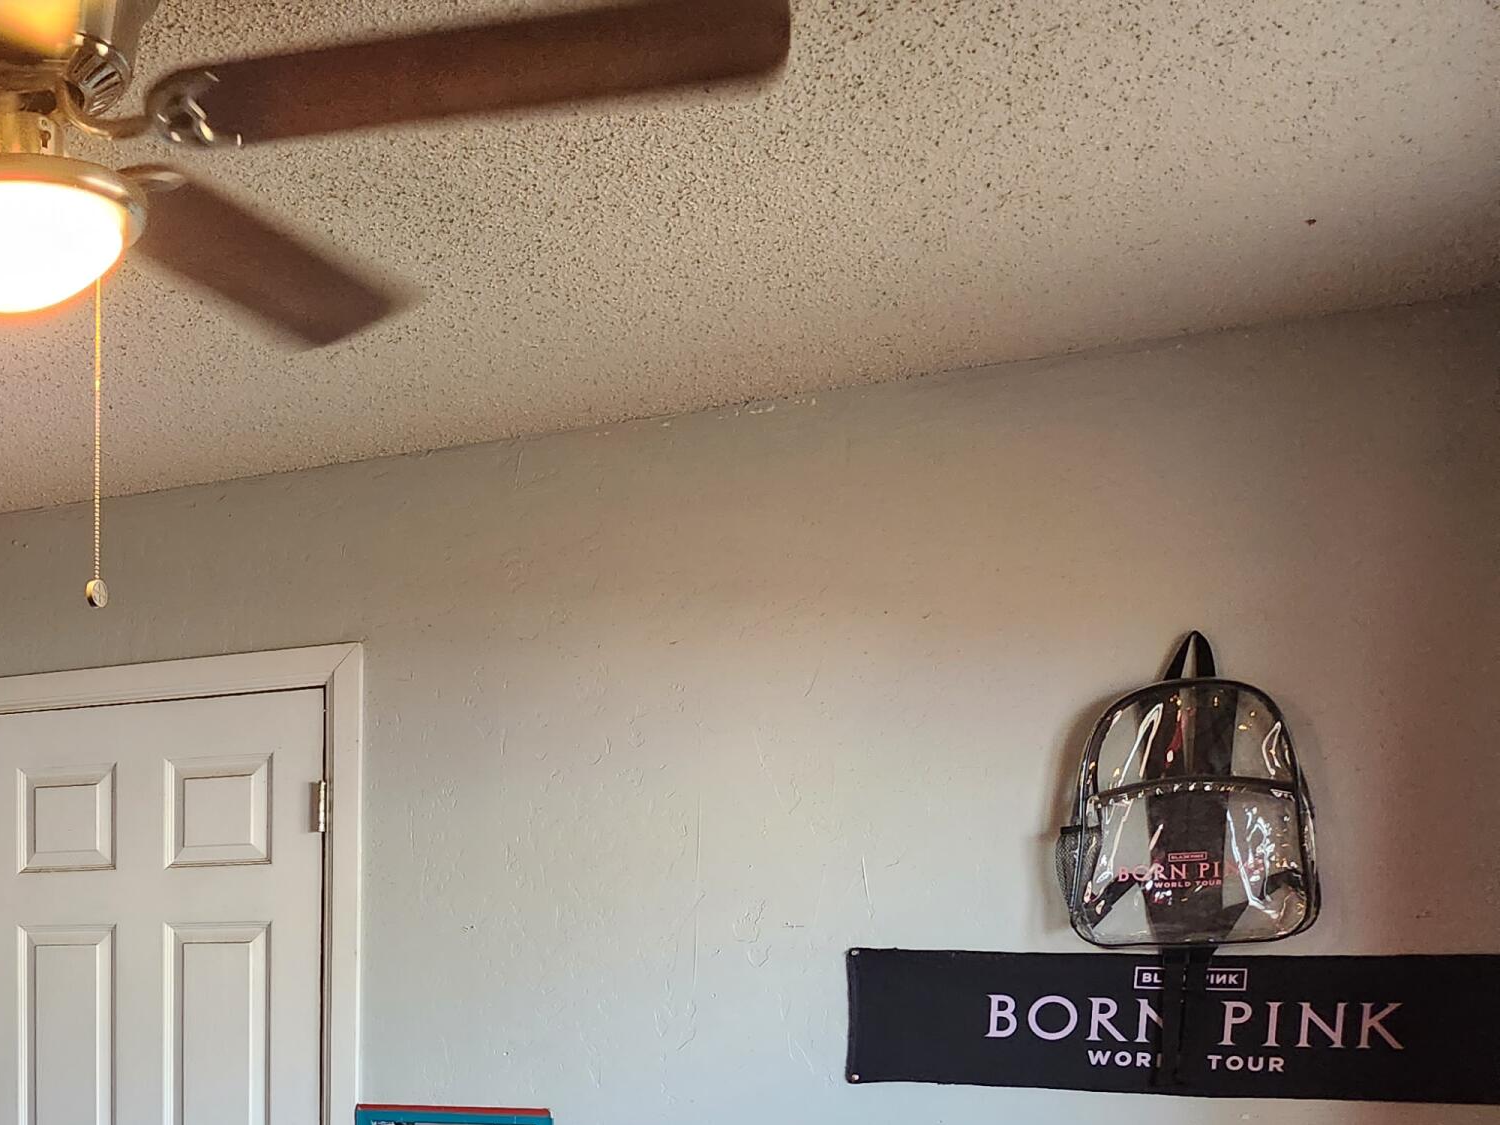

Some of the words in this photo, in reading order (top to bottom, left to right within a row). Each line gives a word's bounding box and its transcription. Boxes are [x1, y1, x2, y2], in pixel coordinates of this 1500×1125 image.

[1117, 863, 1187, 882] BORN
[1153, 880, 1190, 888] WORLD
[1216, 1000, 1406, 1050] PINK
[1207, 1054, 1285, 1073] TOUR
